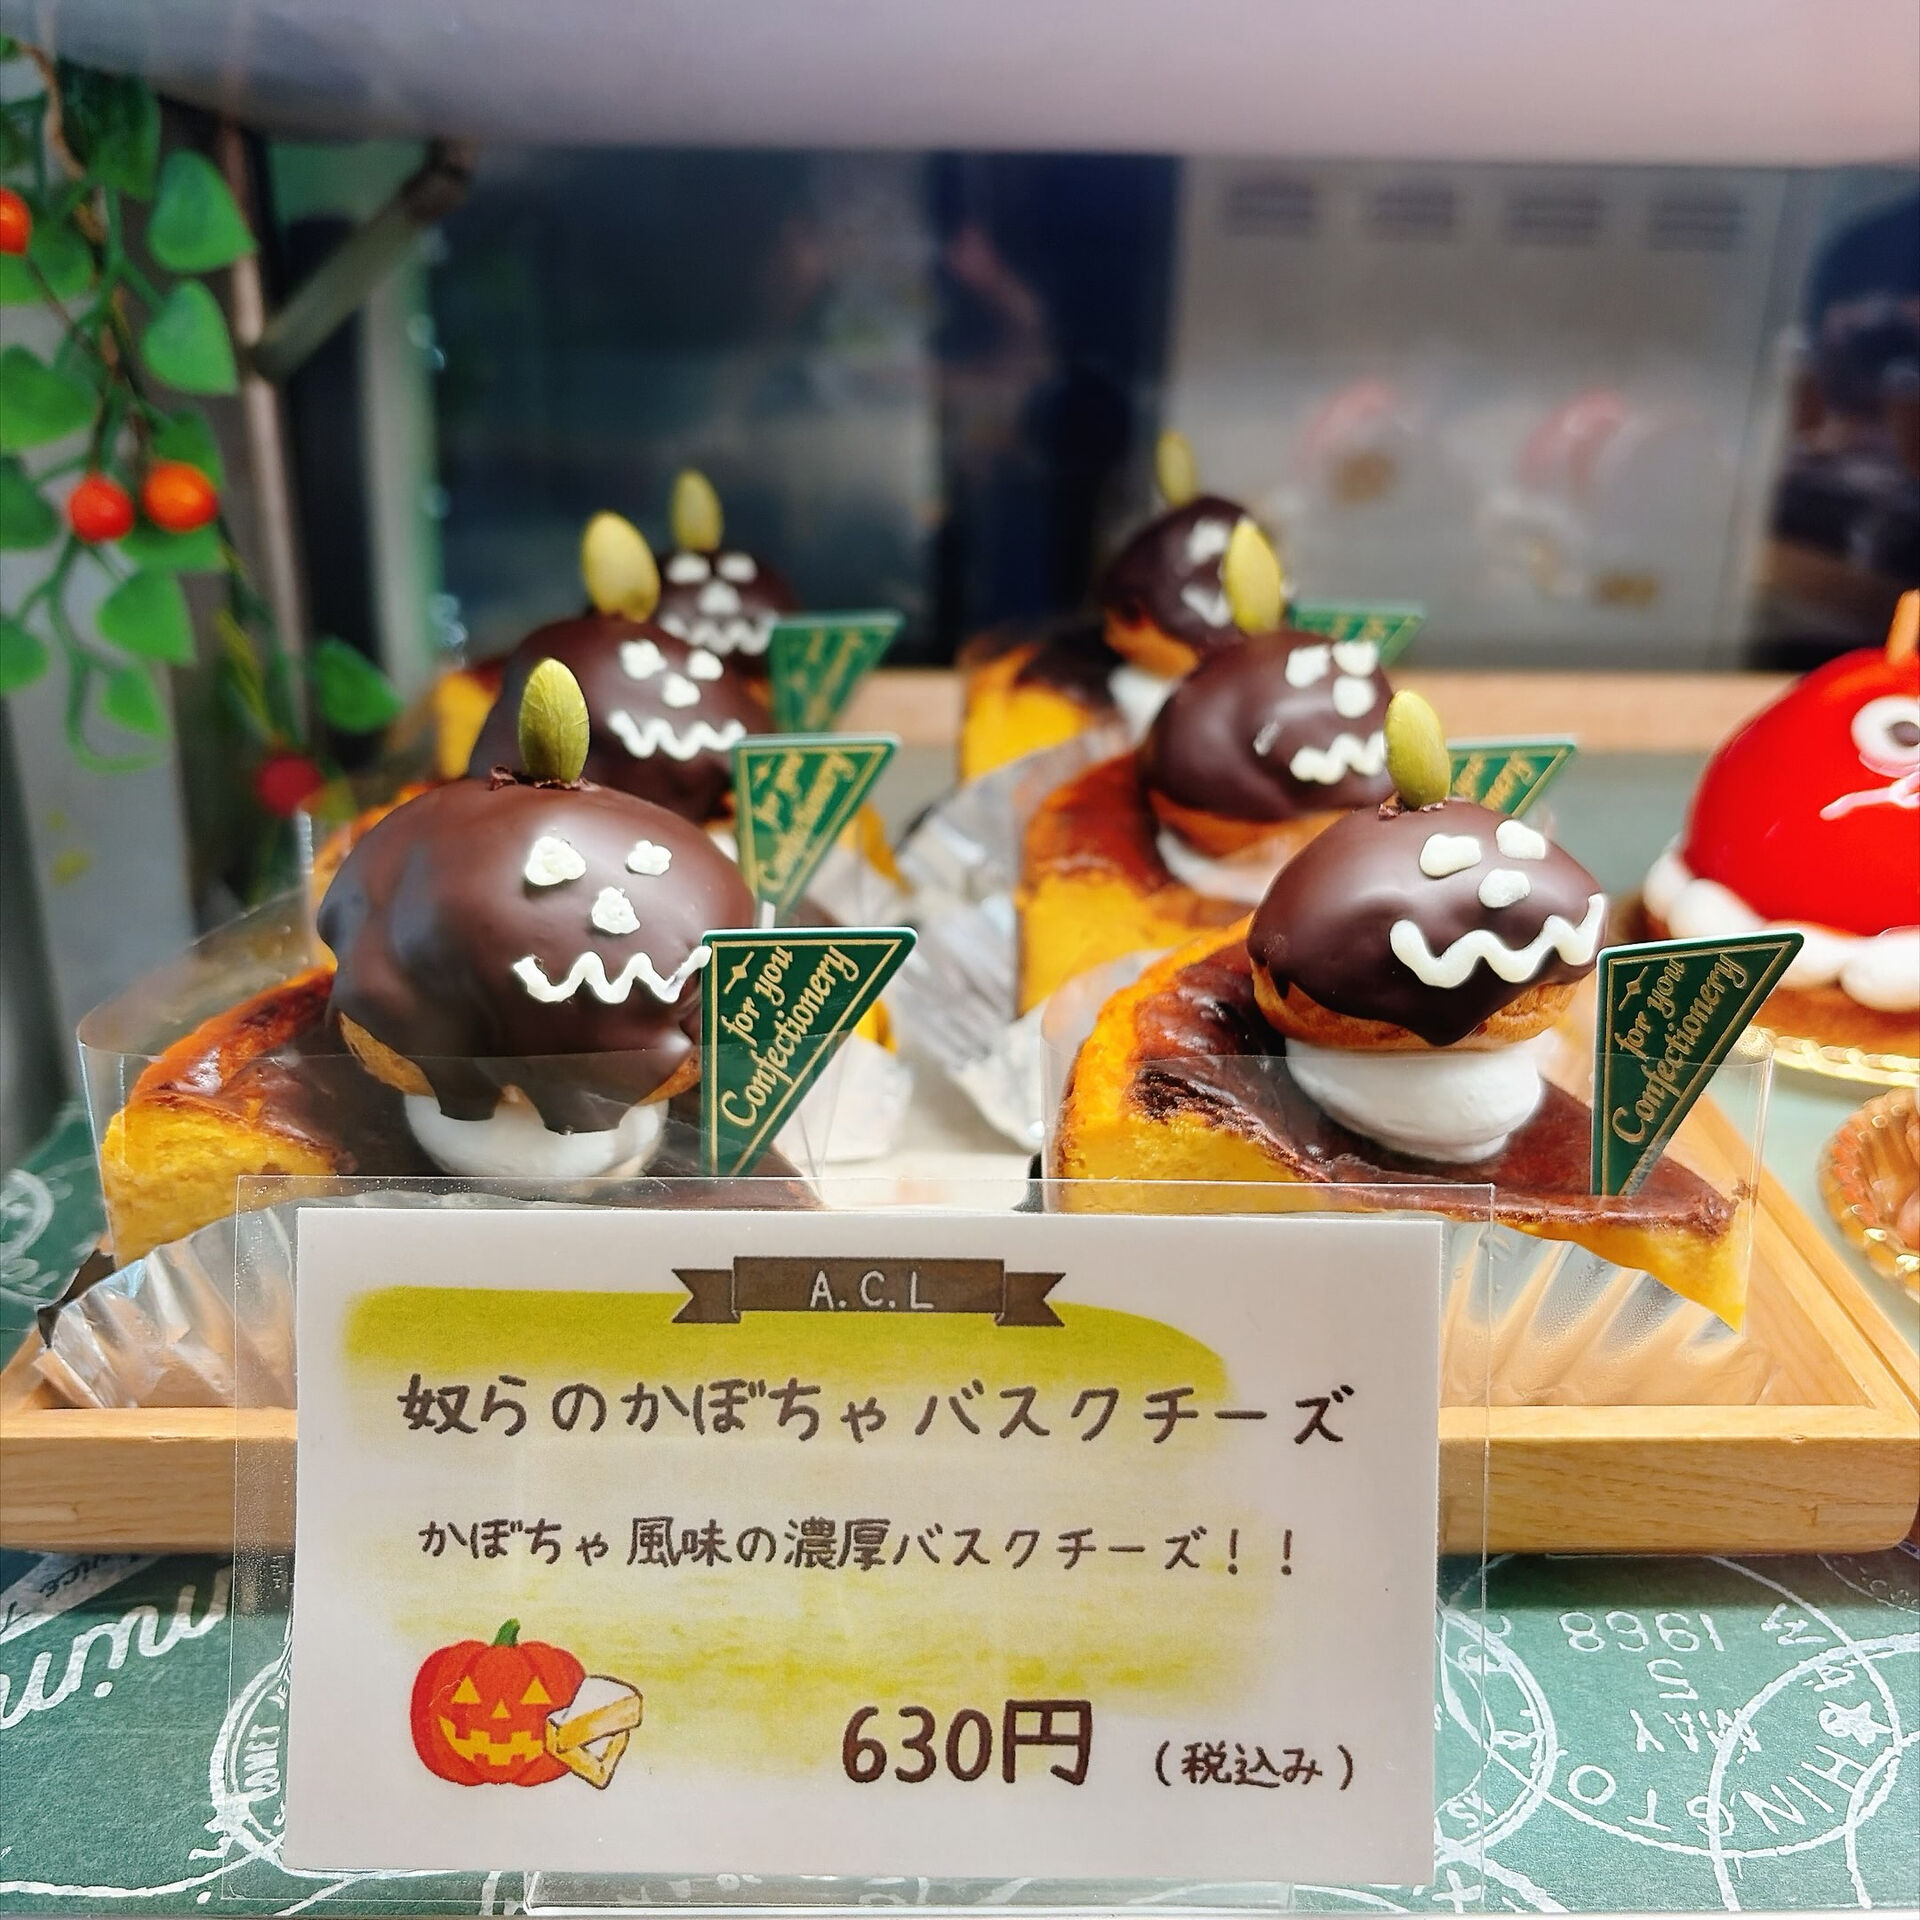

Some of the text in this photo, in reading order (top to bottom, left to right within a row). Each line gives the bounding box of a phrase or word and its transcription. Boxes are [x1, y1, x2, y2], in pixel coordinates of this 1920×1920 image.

[720, 945, 795, 1047] for you
[720, 944, 860, 1129] Confectionery
[1614, 957, 1686, 1063] for you
[1611, 952, 1749, 1145] Confectionery
[809, 1269, 935, 1310] A.C.L
[396, 1372, 1356, 1446] 奴らのかぼちゃバスクチーズ
[1558, 1610, 1726, 1653] 1968
[1646, 1658, 1699, 1700] 5
[840, 1698, 1093, 1787] 630円
[1153, 1739, 1356, 1792] （税込み）
